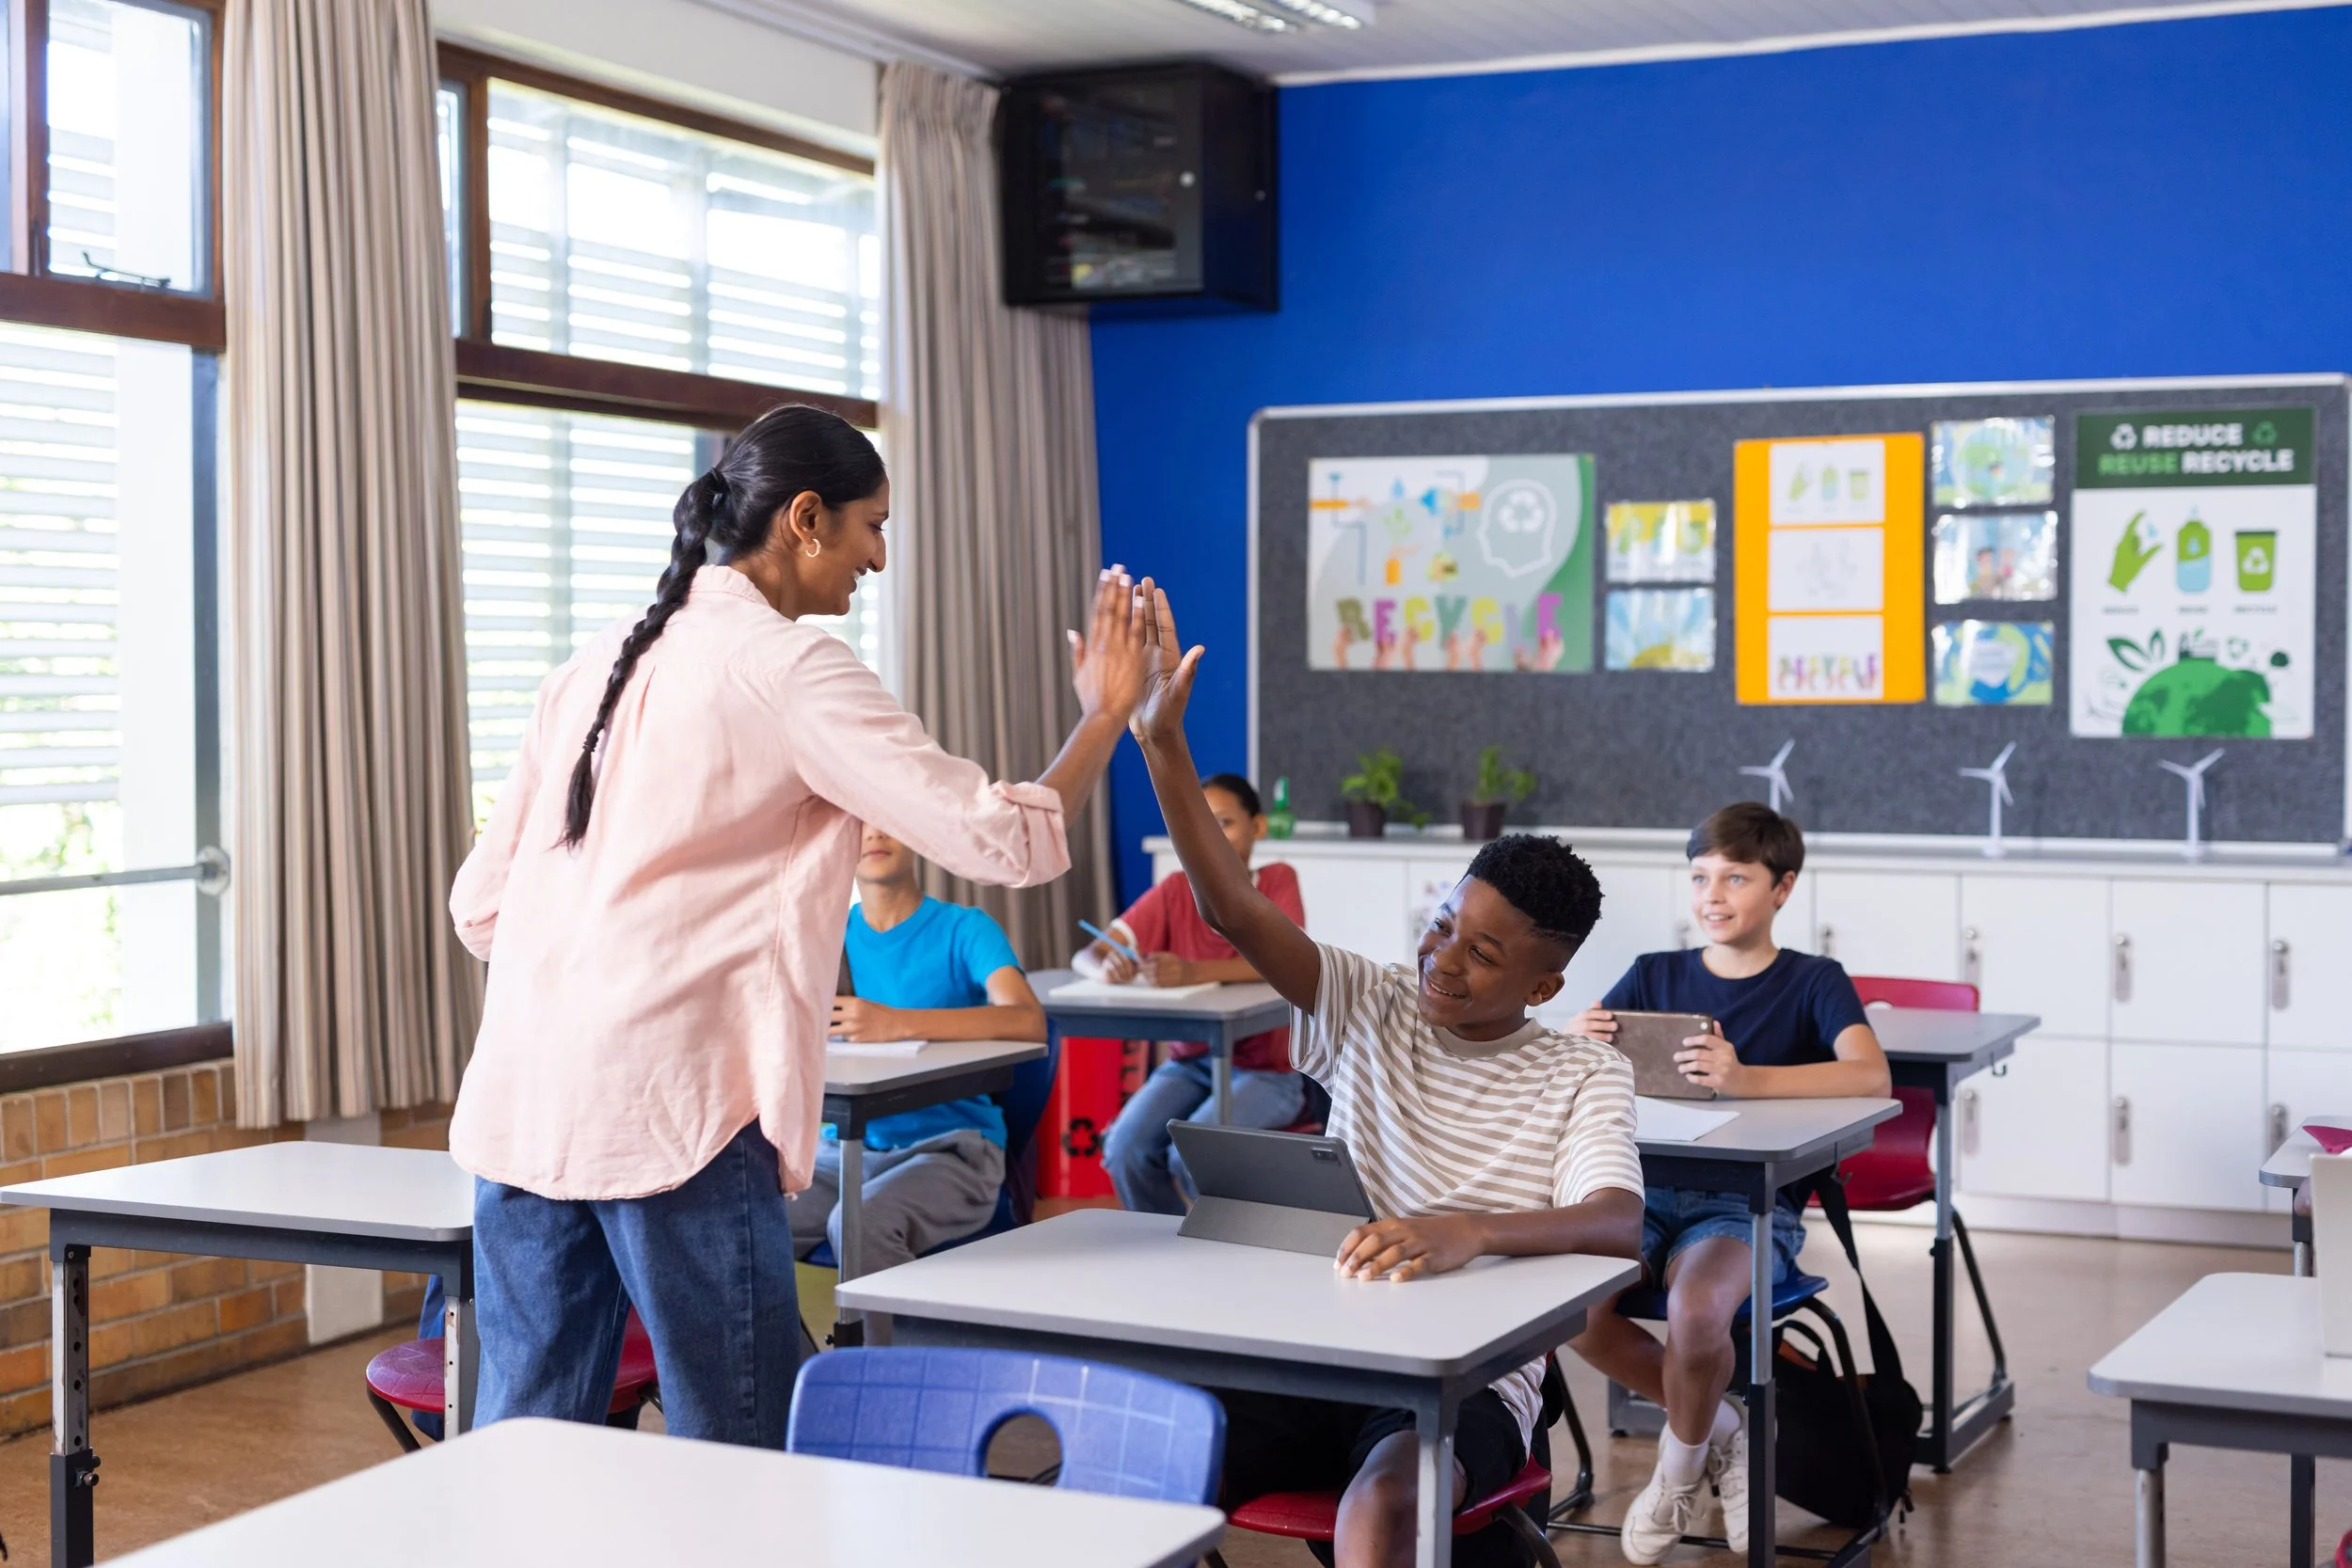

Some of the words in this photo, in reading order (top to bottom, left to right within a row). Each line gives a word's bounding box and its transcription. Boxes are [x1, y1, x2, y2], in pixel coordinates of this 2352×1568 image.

[2143, 423, 2242, 448] REDUCE
[2099, 452, 2178, 475] REUSE
[2182, 449, 2294, 474] RECYCLE
